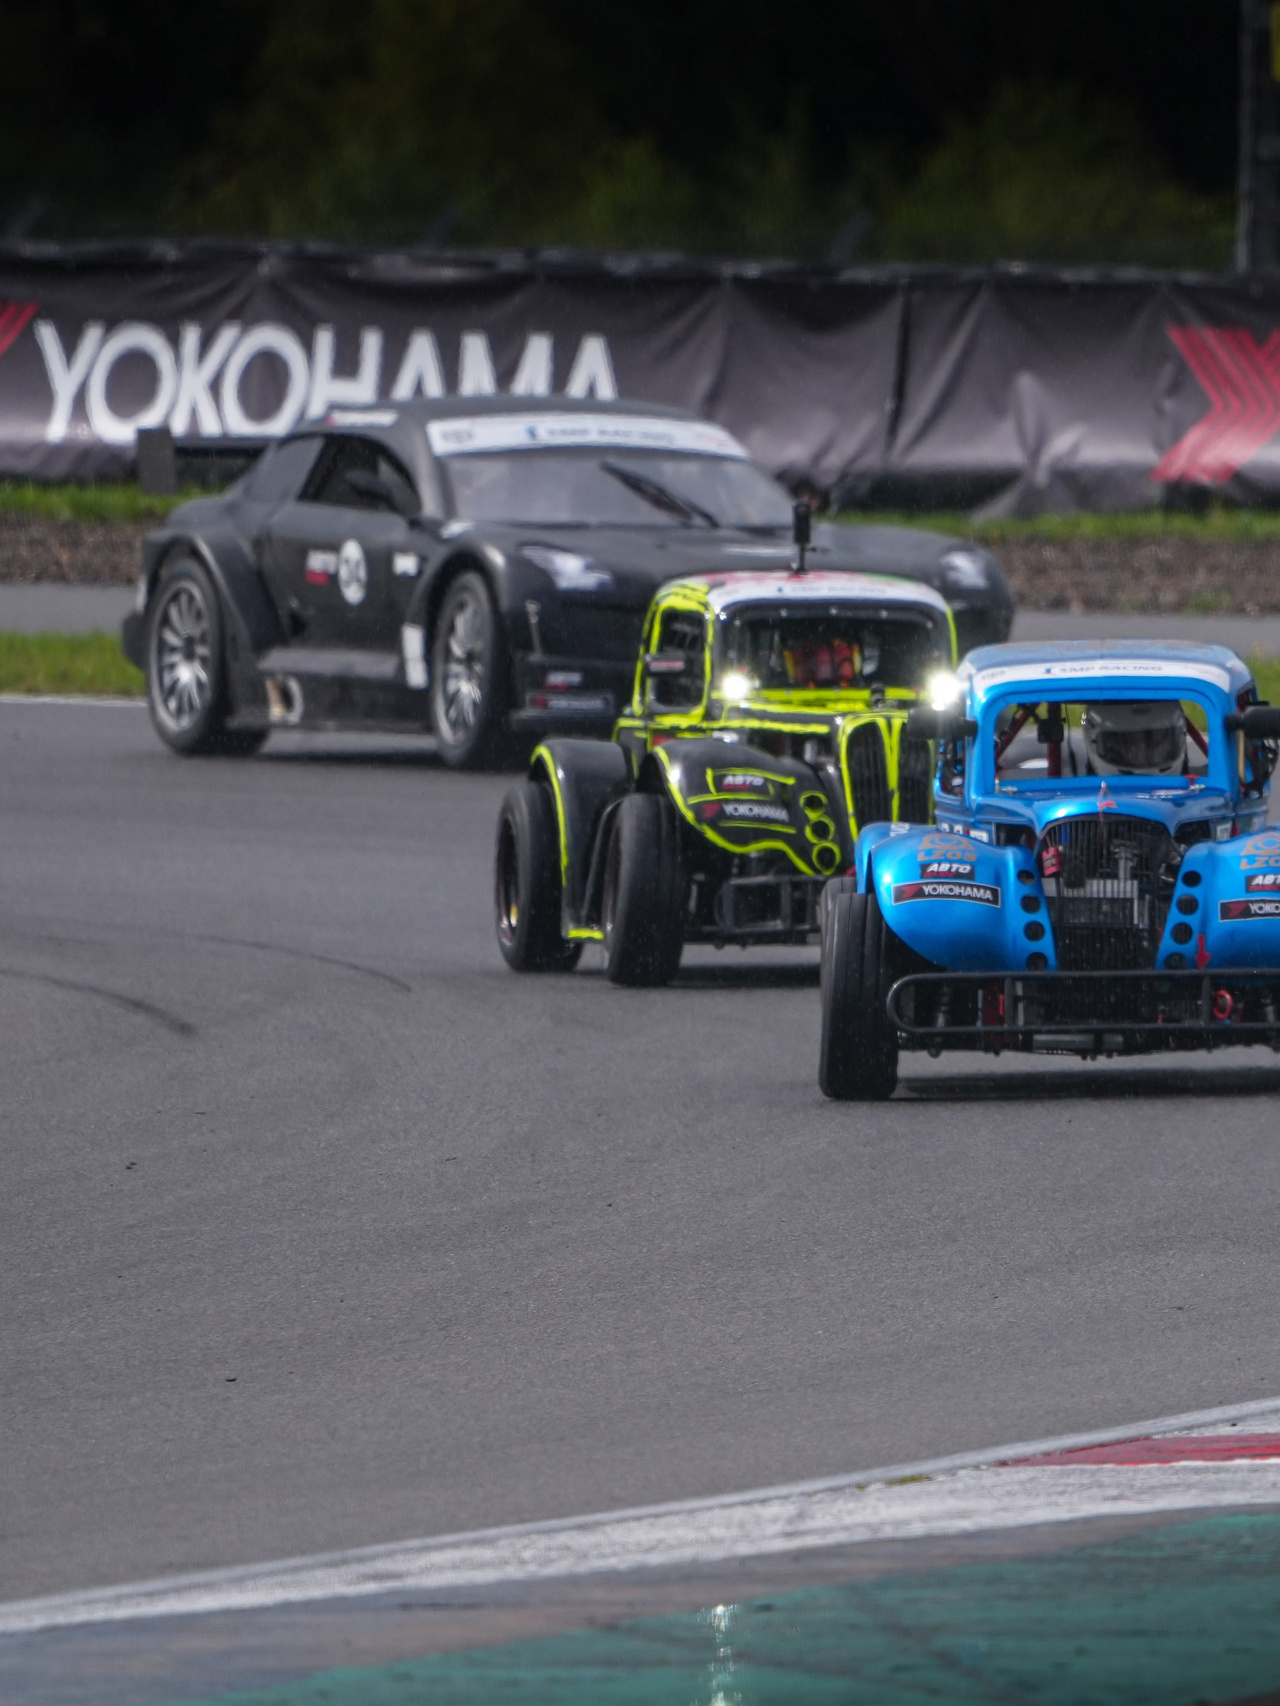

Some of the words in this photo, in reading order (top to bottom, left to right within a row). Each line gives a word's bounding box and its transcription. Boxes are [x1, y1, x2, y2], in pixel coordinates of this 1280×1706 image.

[917, 850, 978, 862] LZOS
[927, 862, 972, 874] АВТО
[921, 883, 993, 900] YOKOHAMA
